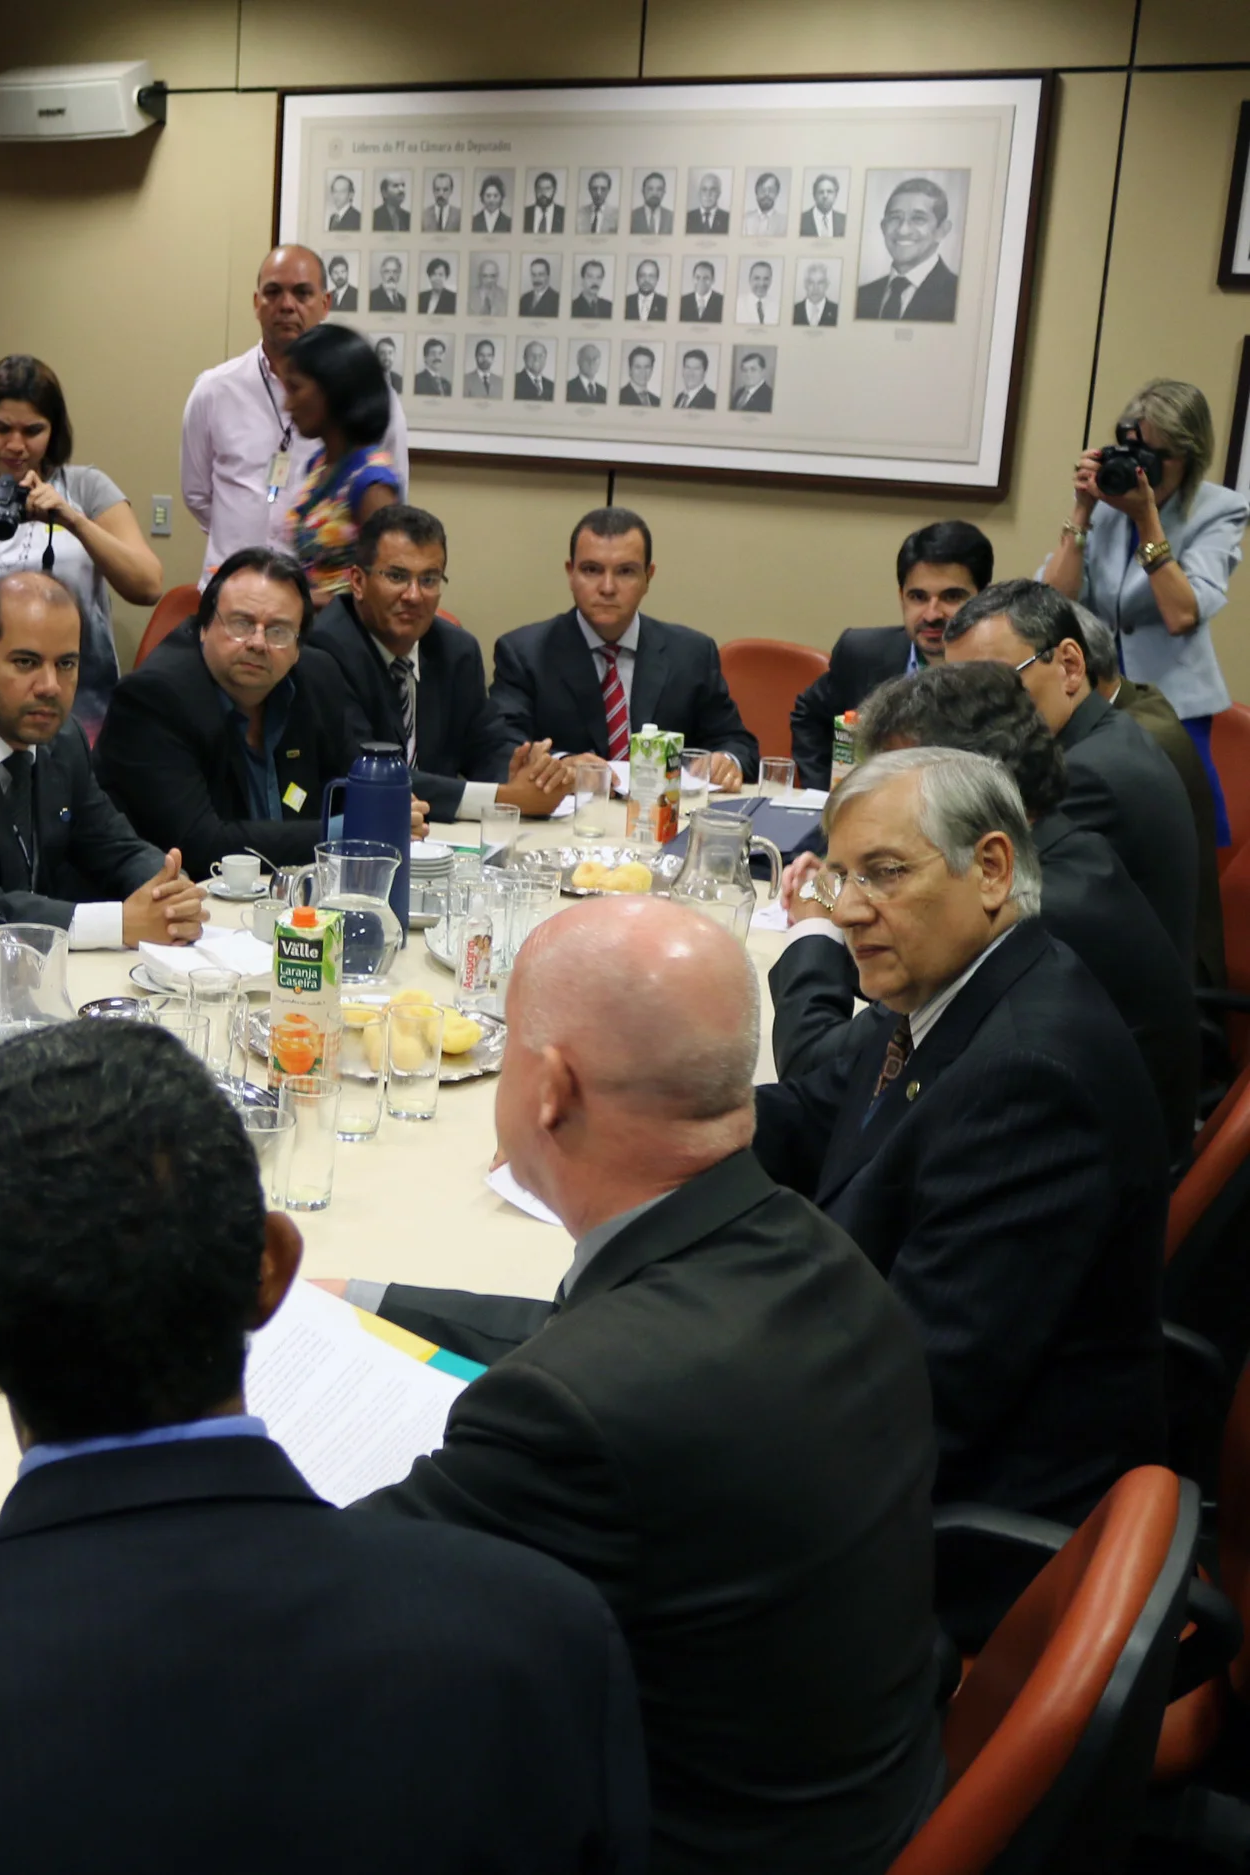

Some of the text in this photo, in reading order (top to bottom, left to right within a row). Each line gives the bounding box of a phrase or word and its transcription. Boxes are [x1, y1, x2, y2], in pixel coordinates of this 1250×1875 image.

[280, 940, 319, 958] Valle
[279, 963, 318, 980] Laranja
[279, 975, 318, 989] Caseira
